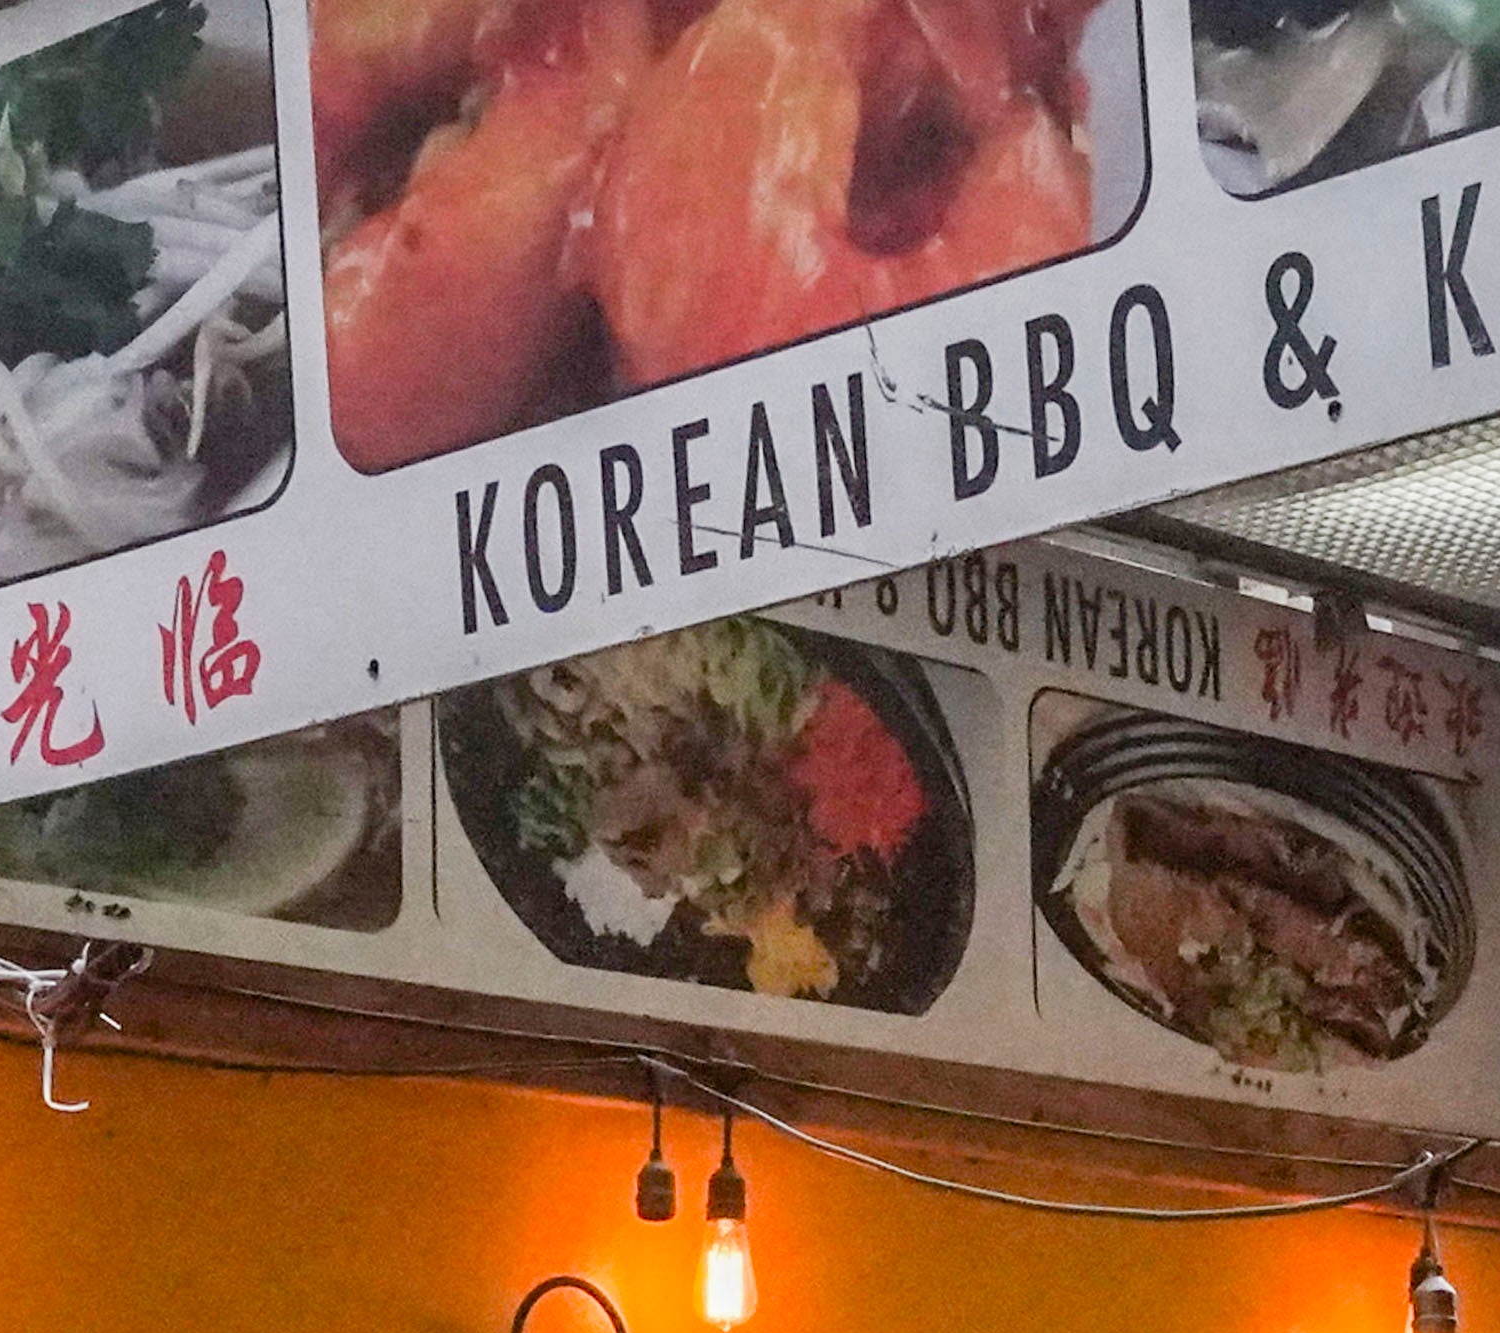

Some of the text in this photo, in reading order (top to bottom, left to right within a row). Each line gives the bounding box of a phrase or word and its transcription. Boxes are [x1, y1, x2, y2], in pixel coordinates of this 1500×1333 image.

[455, 370, 876, 636] KOREAN
[946, 281, 1184, 503] BBQ
[1263, 250, 1344, 414] &
[1042, 571, 1222, 702] KOREAN
